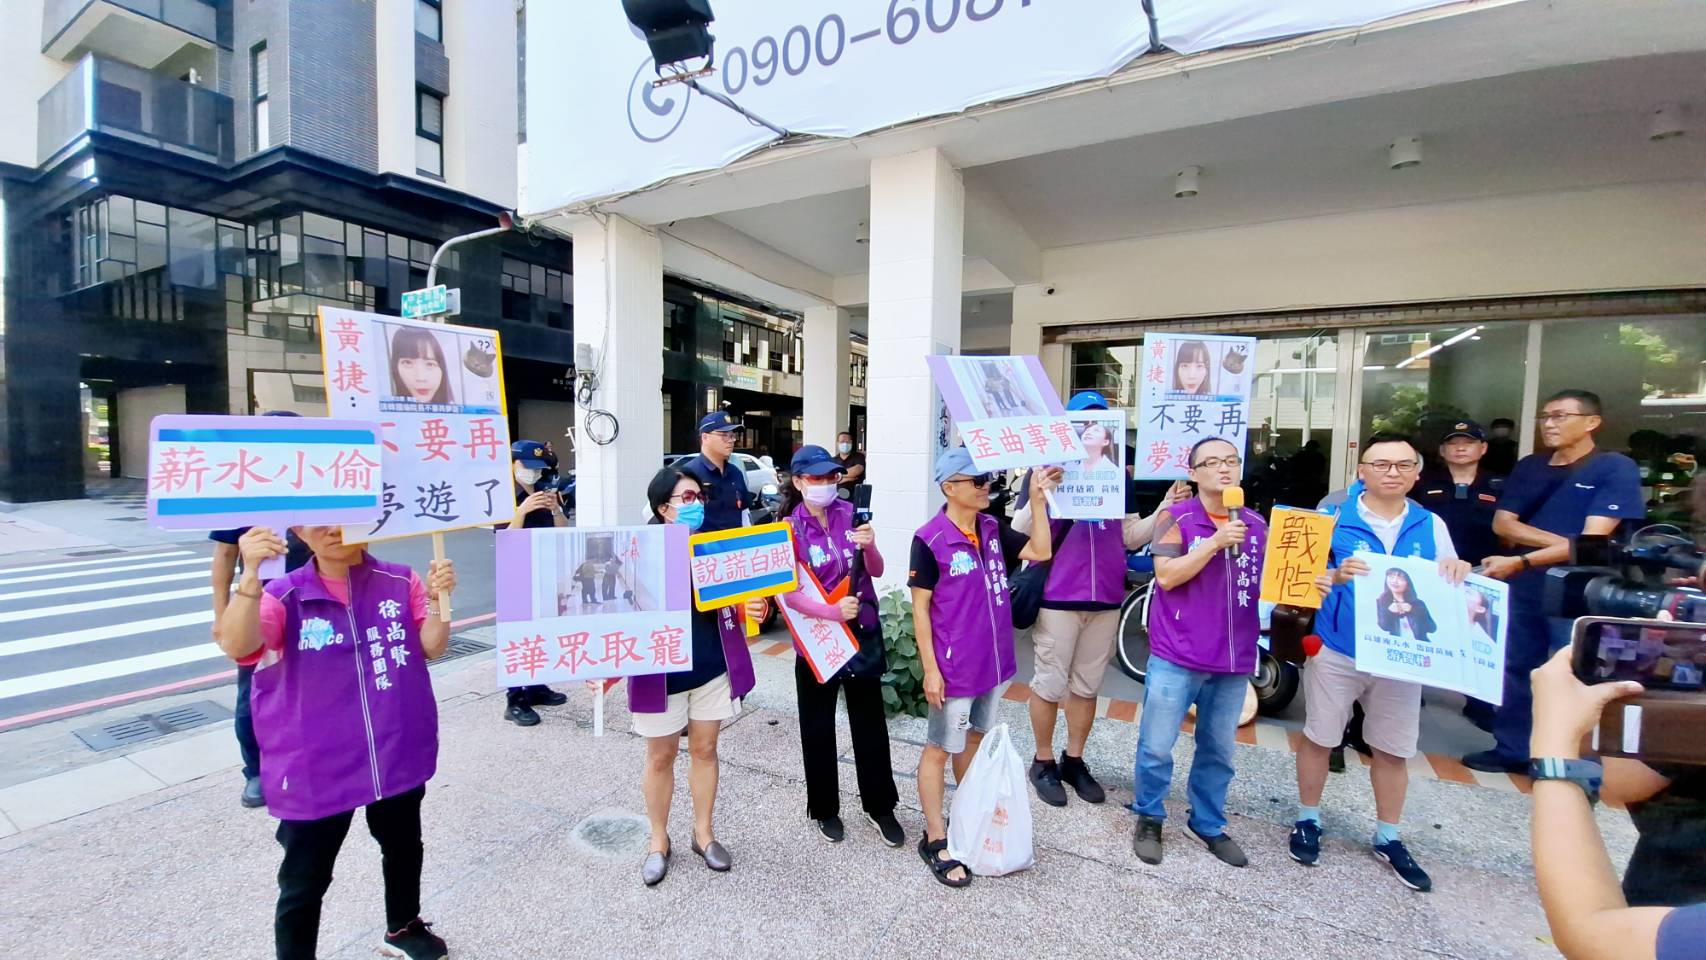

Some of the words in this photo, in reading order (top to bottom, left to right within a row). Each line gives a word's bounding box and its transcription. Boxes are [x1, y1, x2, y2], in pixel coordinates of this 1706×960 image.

[722, 0, 1031, 95] 0900-60
[967, 421, 1077, 460] 歪曲事實
[1150, 403, 1247, 438] 不要再
[152, 445, 381, 493] 薪水小偷
[693, 546, 793, 584] 說謊白賊
[1235, 552, 1251, 607] 徐尚賢
[1276, 516, 1318, 601] 戰帖
[366, 626, 392, 690] 服務團隊
[378, 599, 410, 668] 徐尚賢
[501, 624, 689, 679] 譁眾取寵
